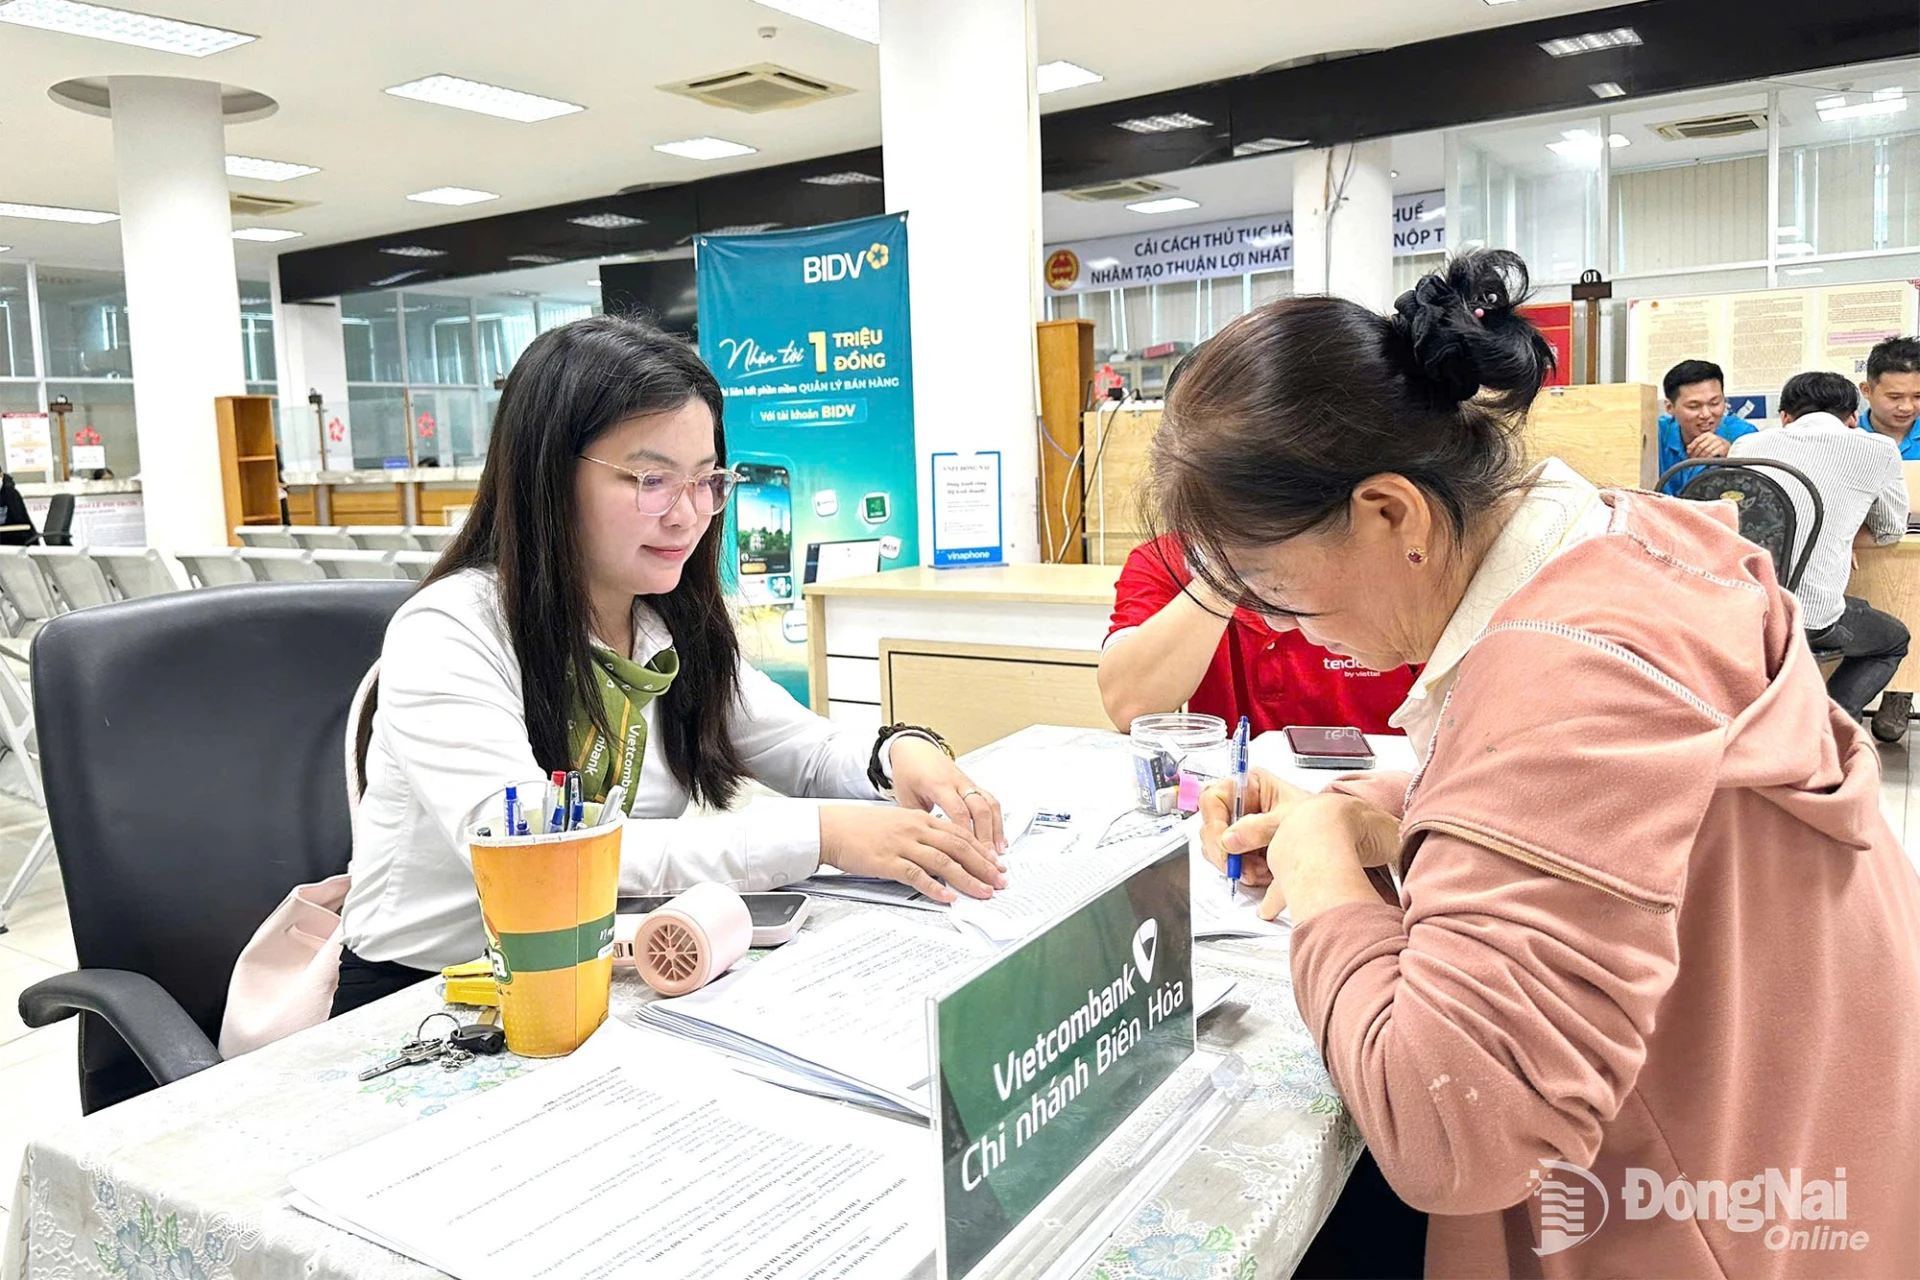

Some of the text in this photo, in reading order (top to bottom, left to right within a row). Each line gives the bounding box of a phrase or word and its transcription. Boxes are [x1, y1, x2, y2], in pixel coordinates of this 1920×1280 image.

[1135, 238, 1157, 257] CẢI
[1161, 235, 1200, 254] CÁCH
[1203, 227, 1234, 248] THỦ
[1136, 263, 1163, 282] TẠO
[1166, 255, 1216, 276] THUẬN
[1221, 250, 1245, 269] LỢI
[1248, 246, 1291, 266] NHẤT
[1393, 228, 1431, 250] NỘP
[803, 250, 867, 284] BIDV
[1583, 271, 1597, 283] 01
[832, 327, 883, 349] TRIỆU
[719, 331, 828, 373] Nhận tới 1
[833, 350, 886, 371] ĐỒNG
[798, 379, 828, 394] QUẢN
[830, 379, 842, 391] LÝ
[844, 378, 866, 390] BÁN
[868, 376, 900, 388] HÀNG
[760, 410, 775, 421] Với
[777, 409, 789, 420] tài
[821, 404, 856, 418] BIDV
[947, 550, 990, 561] vinaphone
[993, 962, 1136, 1101] Vietcombank
[961, 980, 1185, 1192] Chi nhánh Biên Hòa
